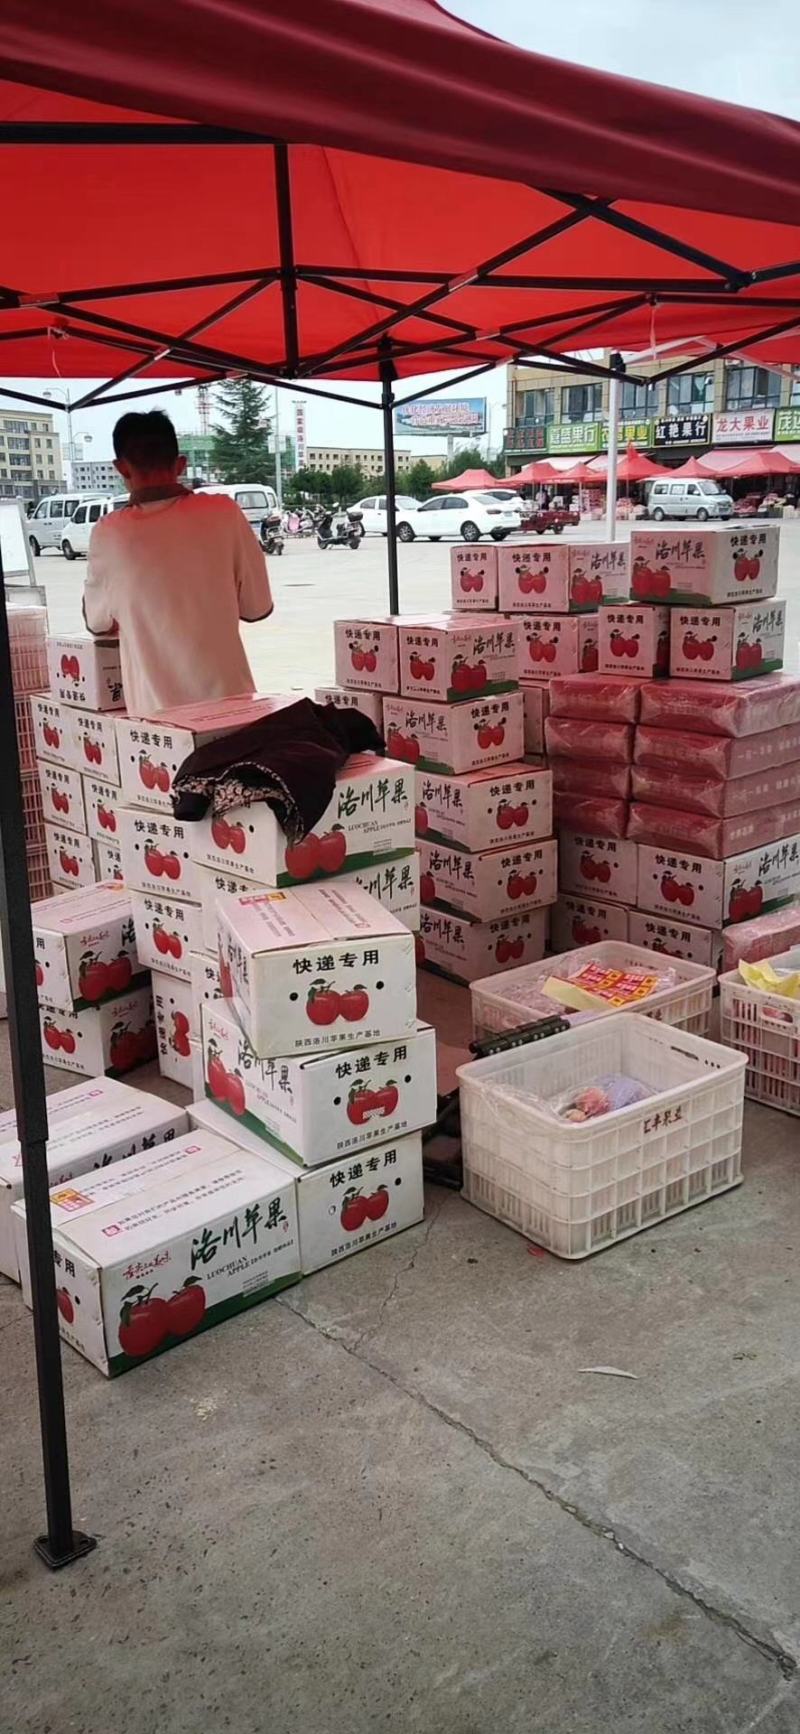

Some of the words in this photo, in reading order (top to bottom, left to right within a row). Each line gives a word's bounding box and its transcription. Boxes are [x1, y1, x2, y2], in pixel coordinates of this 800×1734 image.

[656, 421, 706, 439] 红艳果行
[716, 415, 769, 433] 龙大果业
[730, 533, 767, 546] 快递专用
[456, 552, 488, 563] 快递专用
[512, 553, 552, 563] 快递专用
[655, 541, 706, 562] 洛川苹果
[523, 620, 562, 632] 快递专用
[607, 613, 644, 625] 快递专用
[679, 615, 721, 627] 快递专用
[345, 628, 381, 642] 快递专用
[406, 635, 439, 648] 快递专用
[472, 633, 516, 655] 洛川苹果
[470, 701, 510, 718] 快递专用
[405, 711, 447, 733] 洛川苹果
[130, 730, 173, 749] 快递专用
[421, 781, 464, 808] 洛川苹果
[489, 779, 536, 796] 快递专用
[337, 777, 409, 820] 洛川苹果
[134, 819, 185, 840] 快递专用
[574, 836, 617, 852] 快递专用
[429, 850, 475, 880] 洛川苹果
[500, 849, 543, 869] 快递专用
[655, 854, 703, 874] 快递专用
[144, 899, 185, 921] 快递专用
[645, 922, 692, 943] 快递专用
[292, 950, 380, 974] 快递专用
[294, 1028, 382, 1048] 陕西洛川苹果生产基地
[335, 1044, 408, 1079] 快递专用
[336, 1120, 409, 1150] 陕西洛川苹果生产基地
[329, 1149, 398, 1188] 快递专用
[191, 1196, 288, 1272] 洛川苹果
[330, 1221, 398, 1258] 陕西洛川苹果生产基地
[206, 1255, 248, 1281] LUOCHUAN
[227, 1260, 250, 1278] APPLE
